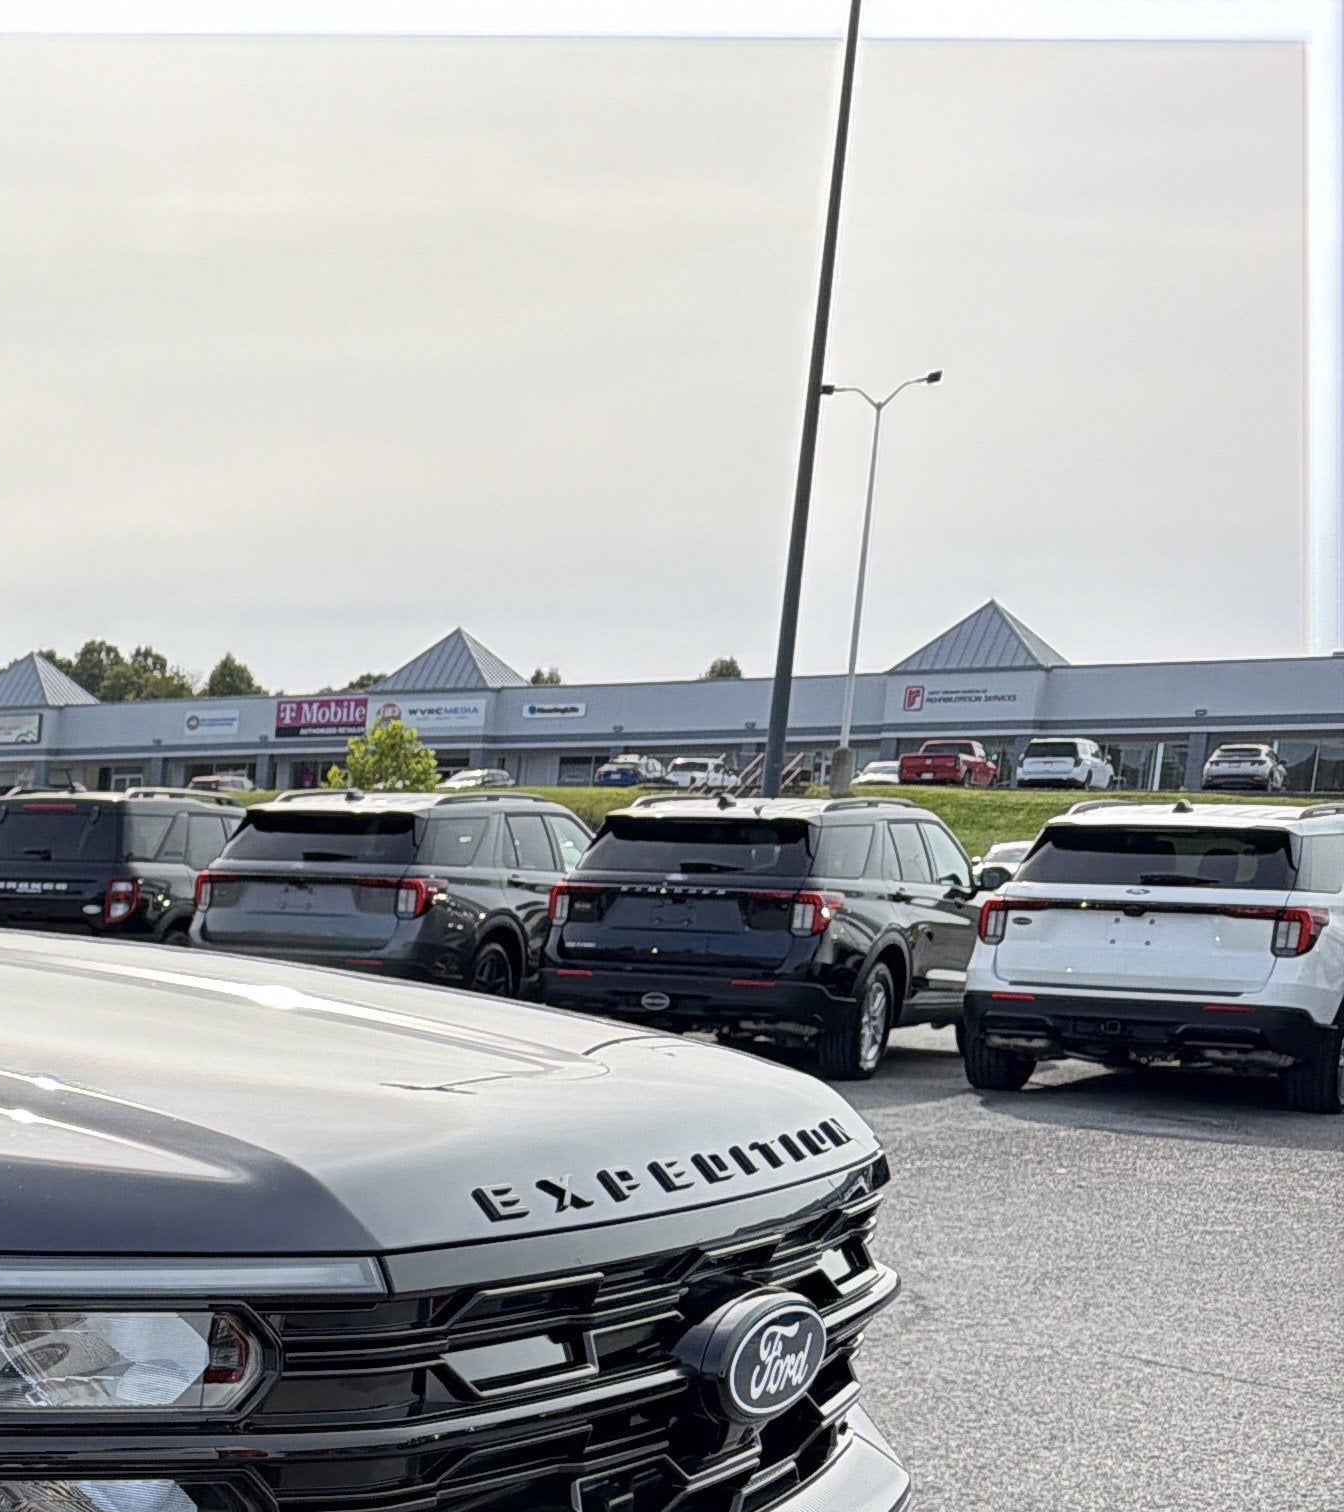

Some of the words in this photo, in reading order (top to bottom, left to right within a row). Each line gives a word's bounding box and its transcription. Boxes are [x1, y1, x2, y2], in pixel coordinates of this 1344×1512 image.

[300, 700, 366, 724] Mobile
[470, 1116, 854, 1223] EXPEDITION
[750, 1321, 813, 1400] Ford
